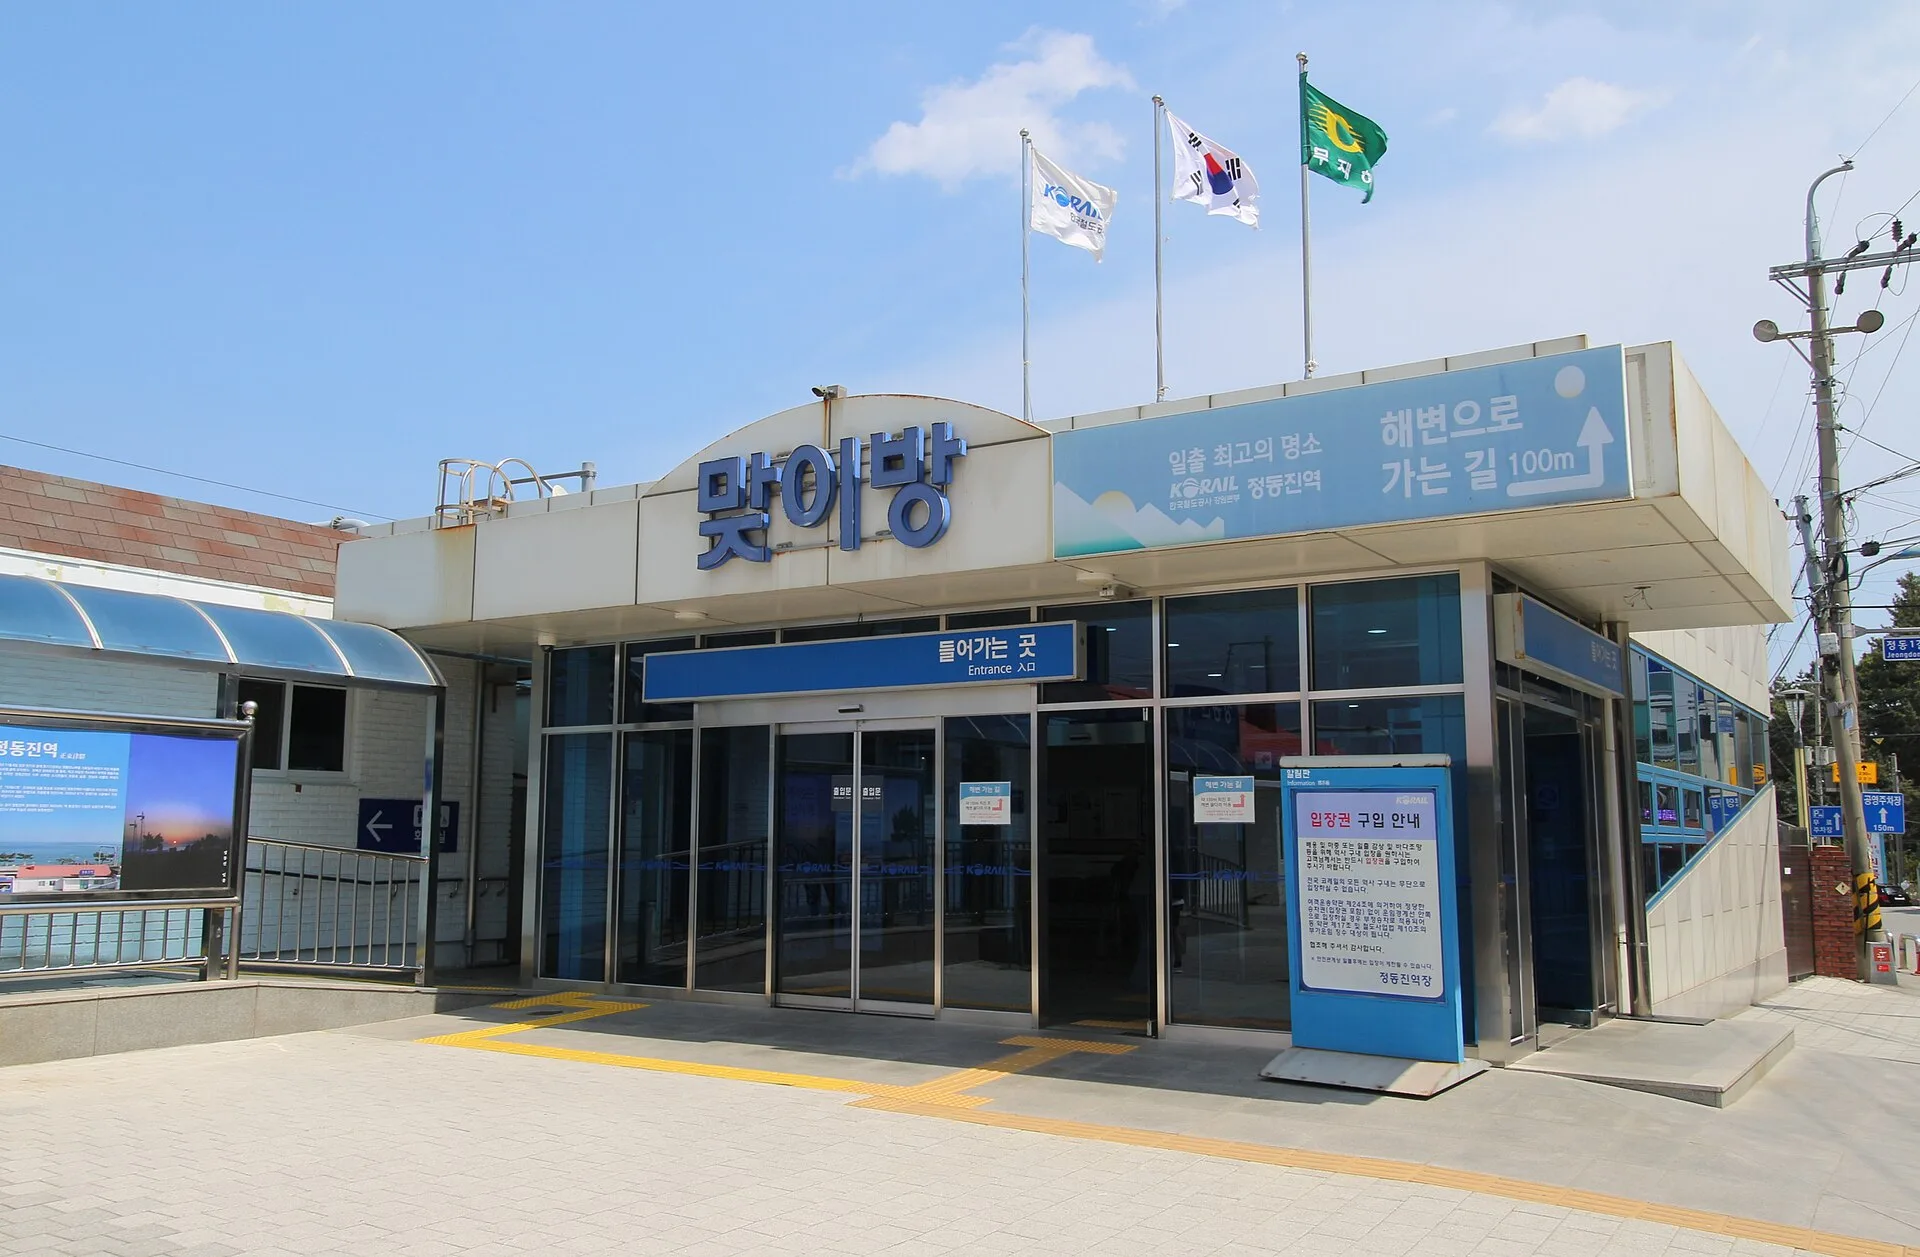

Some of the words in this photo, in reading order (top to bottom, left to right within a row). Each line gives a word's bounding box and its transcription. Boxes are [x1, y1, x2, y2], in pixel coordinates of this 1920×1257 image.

[1380, 395, 1523, 447] 해변으로
[1169, 448, 1206, 475] 일출
[1213, 438, 1272, 468] 최고의
[1281, 433, 1322, 459] 명소
[1382, 457, 1450, 498] 가는
[1464, 448, 1497, 490] 길
[1509, 449, 1574, 475] 100m
[1170, 476, 1238, 498] KORAIL
[1248, 470, 1320, 499] 정동진역
[696, 422, 968, 571] 맞이방
[939, 637, 1008, 662] 들어가는
[1019, 634, 1036, 658] 곳
[969, 664, 1012, 676] Entrance
[1017, 662, 1035, 672] 入口
[1287, 769, 1310, 779] 알림판
[1396, 796, 1428, 804] KORAIL
[1864, 795, 1901, 806] 공영주차장
[1311, 812, 1351, 828] 입장권
[1358, 813, 1384, 828] 구입
[1392, 813, 1420, 828] 안내
[1380, 972, 1432, 987] 정동진역장
